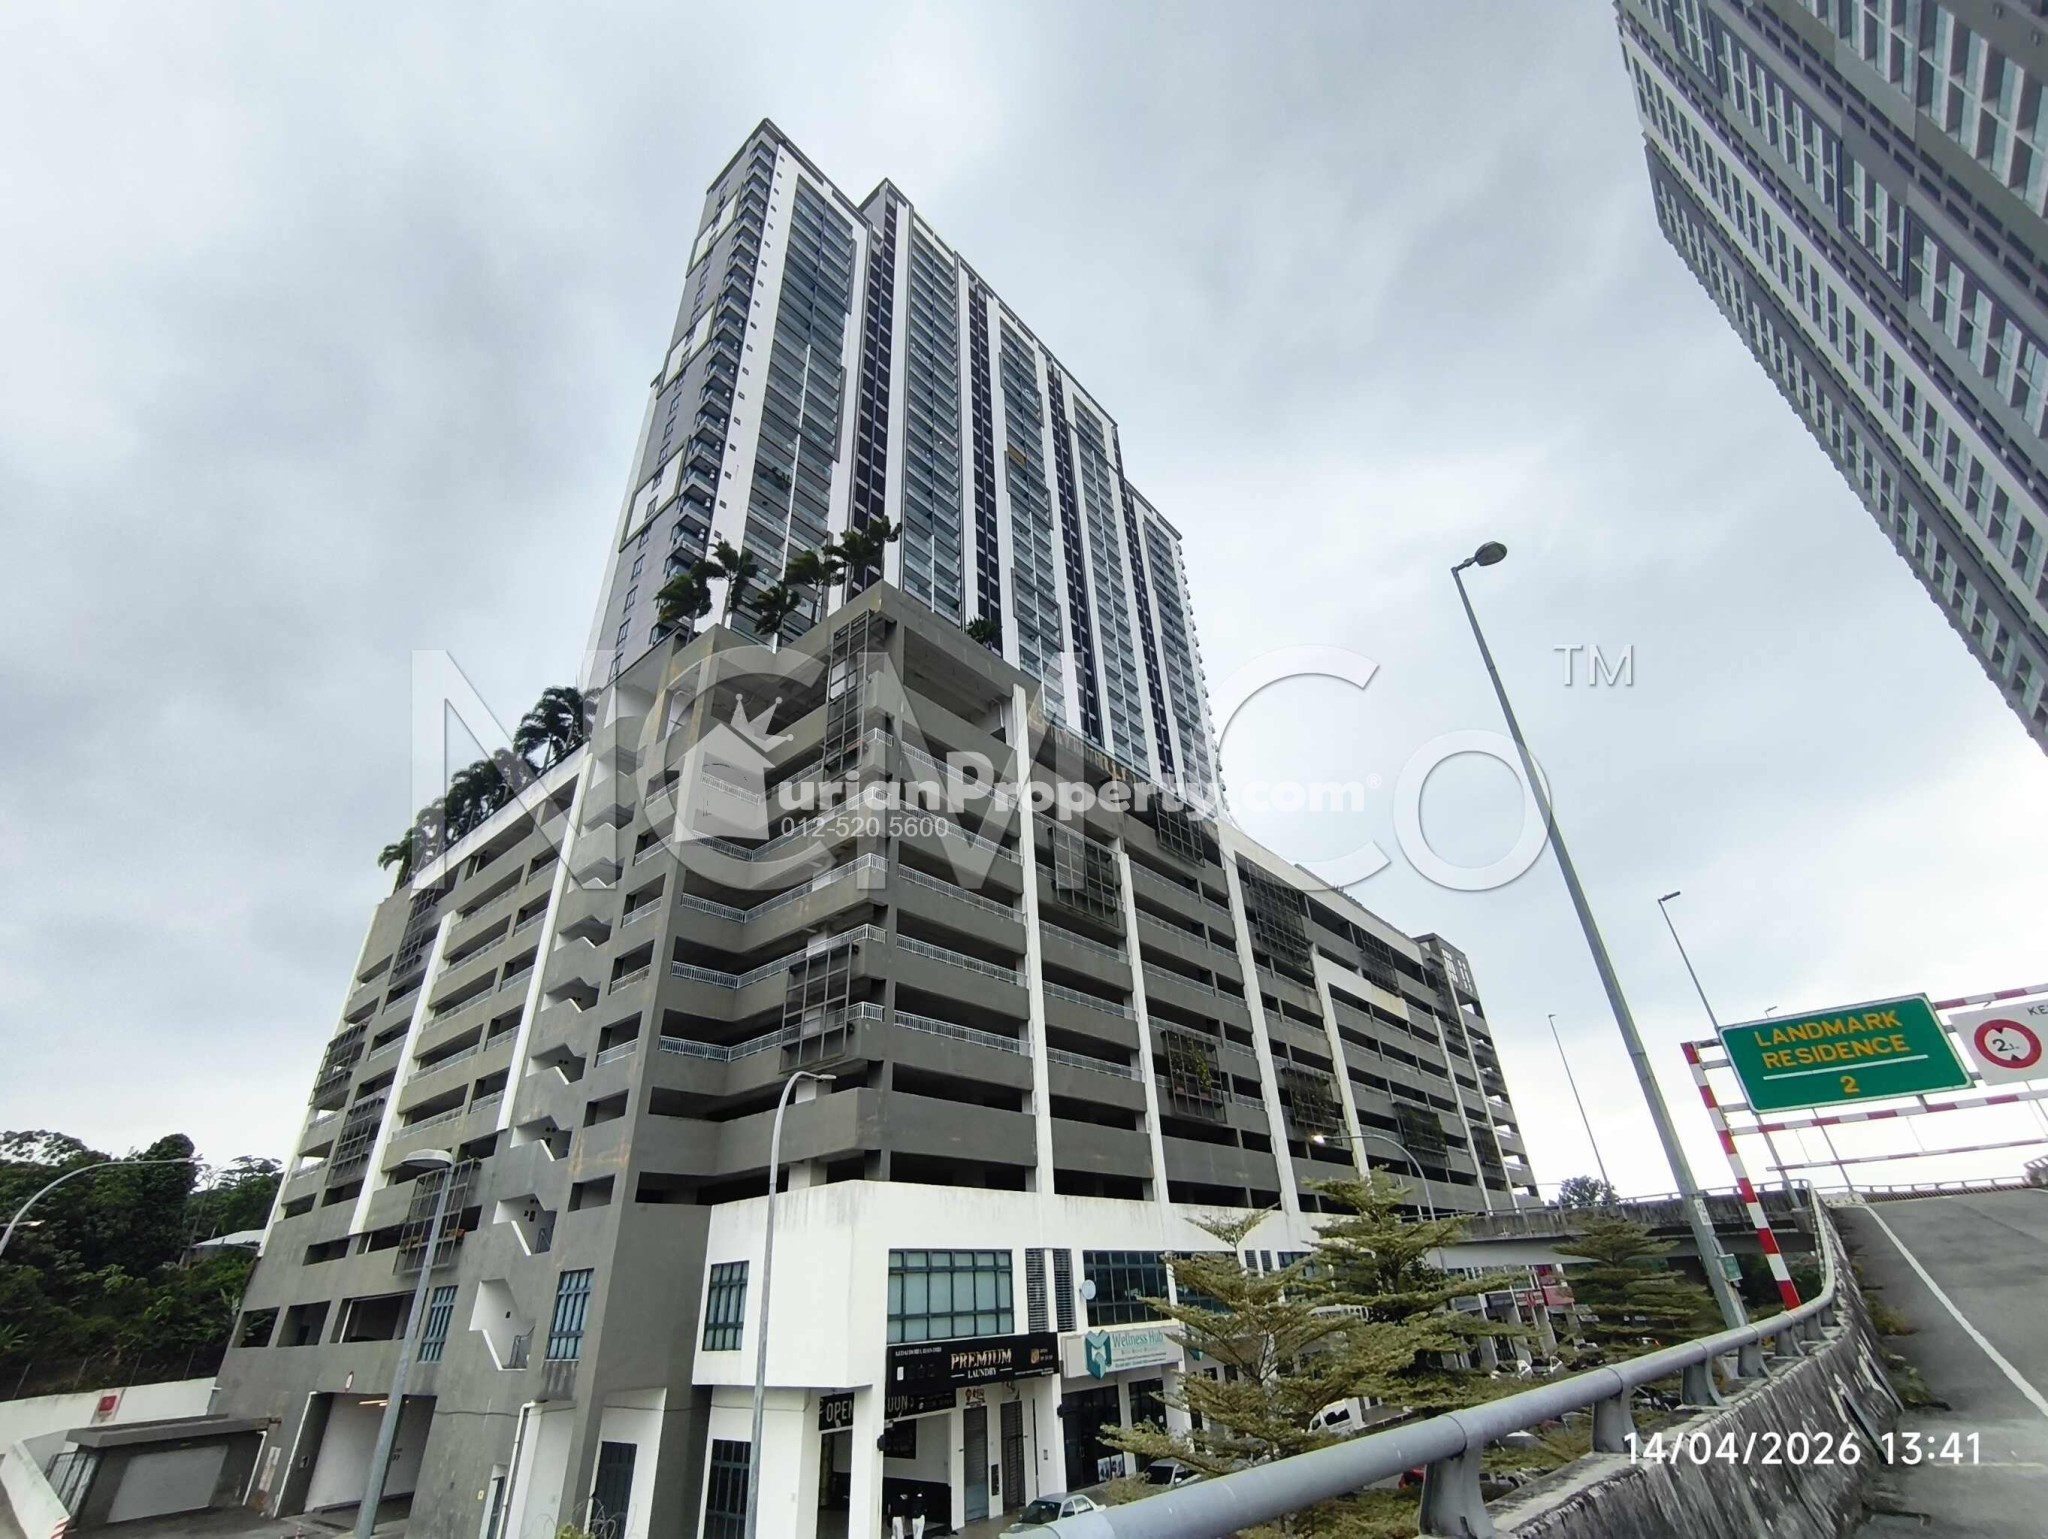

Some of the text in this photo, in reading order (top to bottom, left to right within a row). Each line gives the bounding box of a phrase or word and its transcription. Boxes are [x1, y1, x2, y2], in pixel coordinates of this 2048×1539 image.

[2027, 1004, 2048, 1016] KE
[1754, 1009, 1903, 1048] LANDMARK
[1761, 1034, 1911, 1069] RESIDENCE
[1839, 1075, 1861, 1094] 2
[1111, 1330, 1165, 1348] Wellness Hub
[950, 1348, 1013, 1370] PREMIUM
[967, 1367, 997, 1379] LAUNDRY
